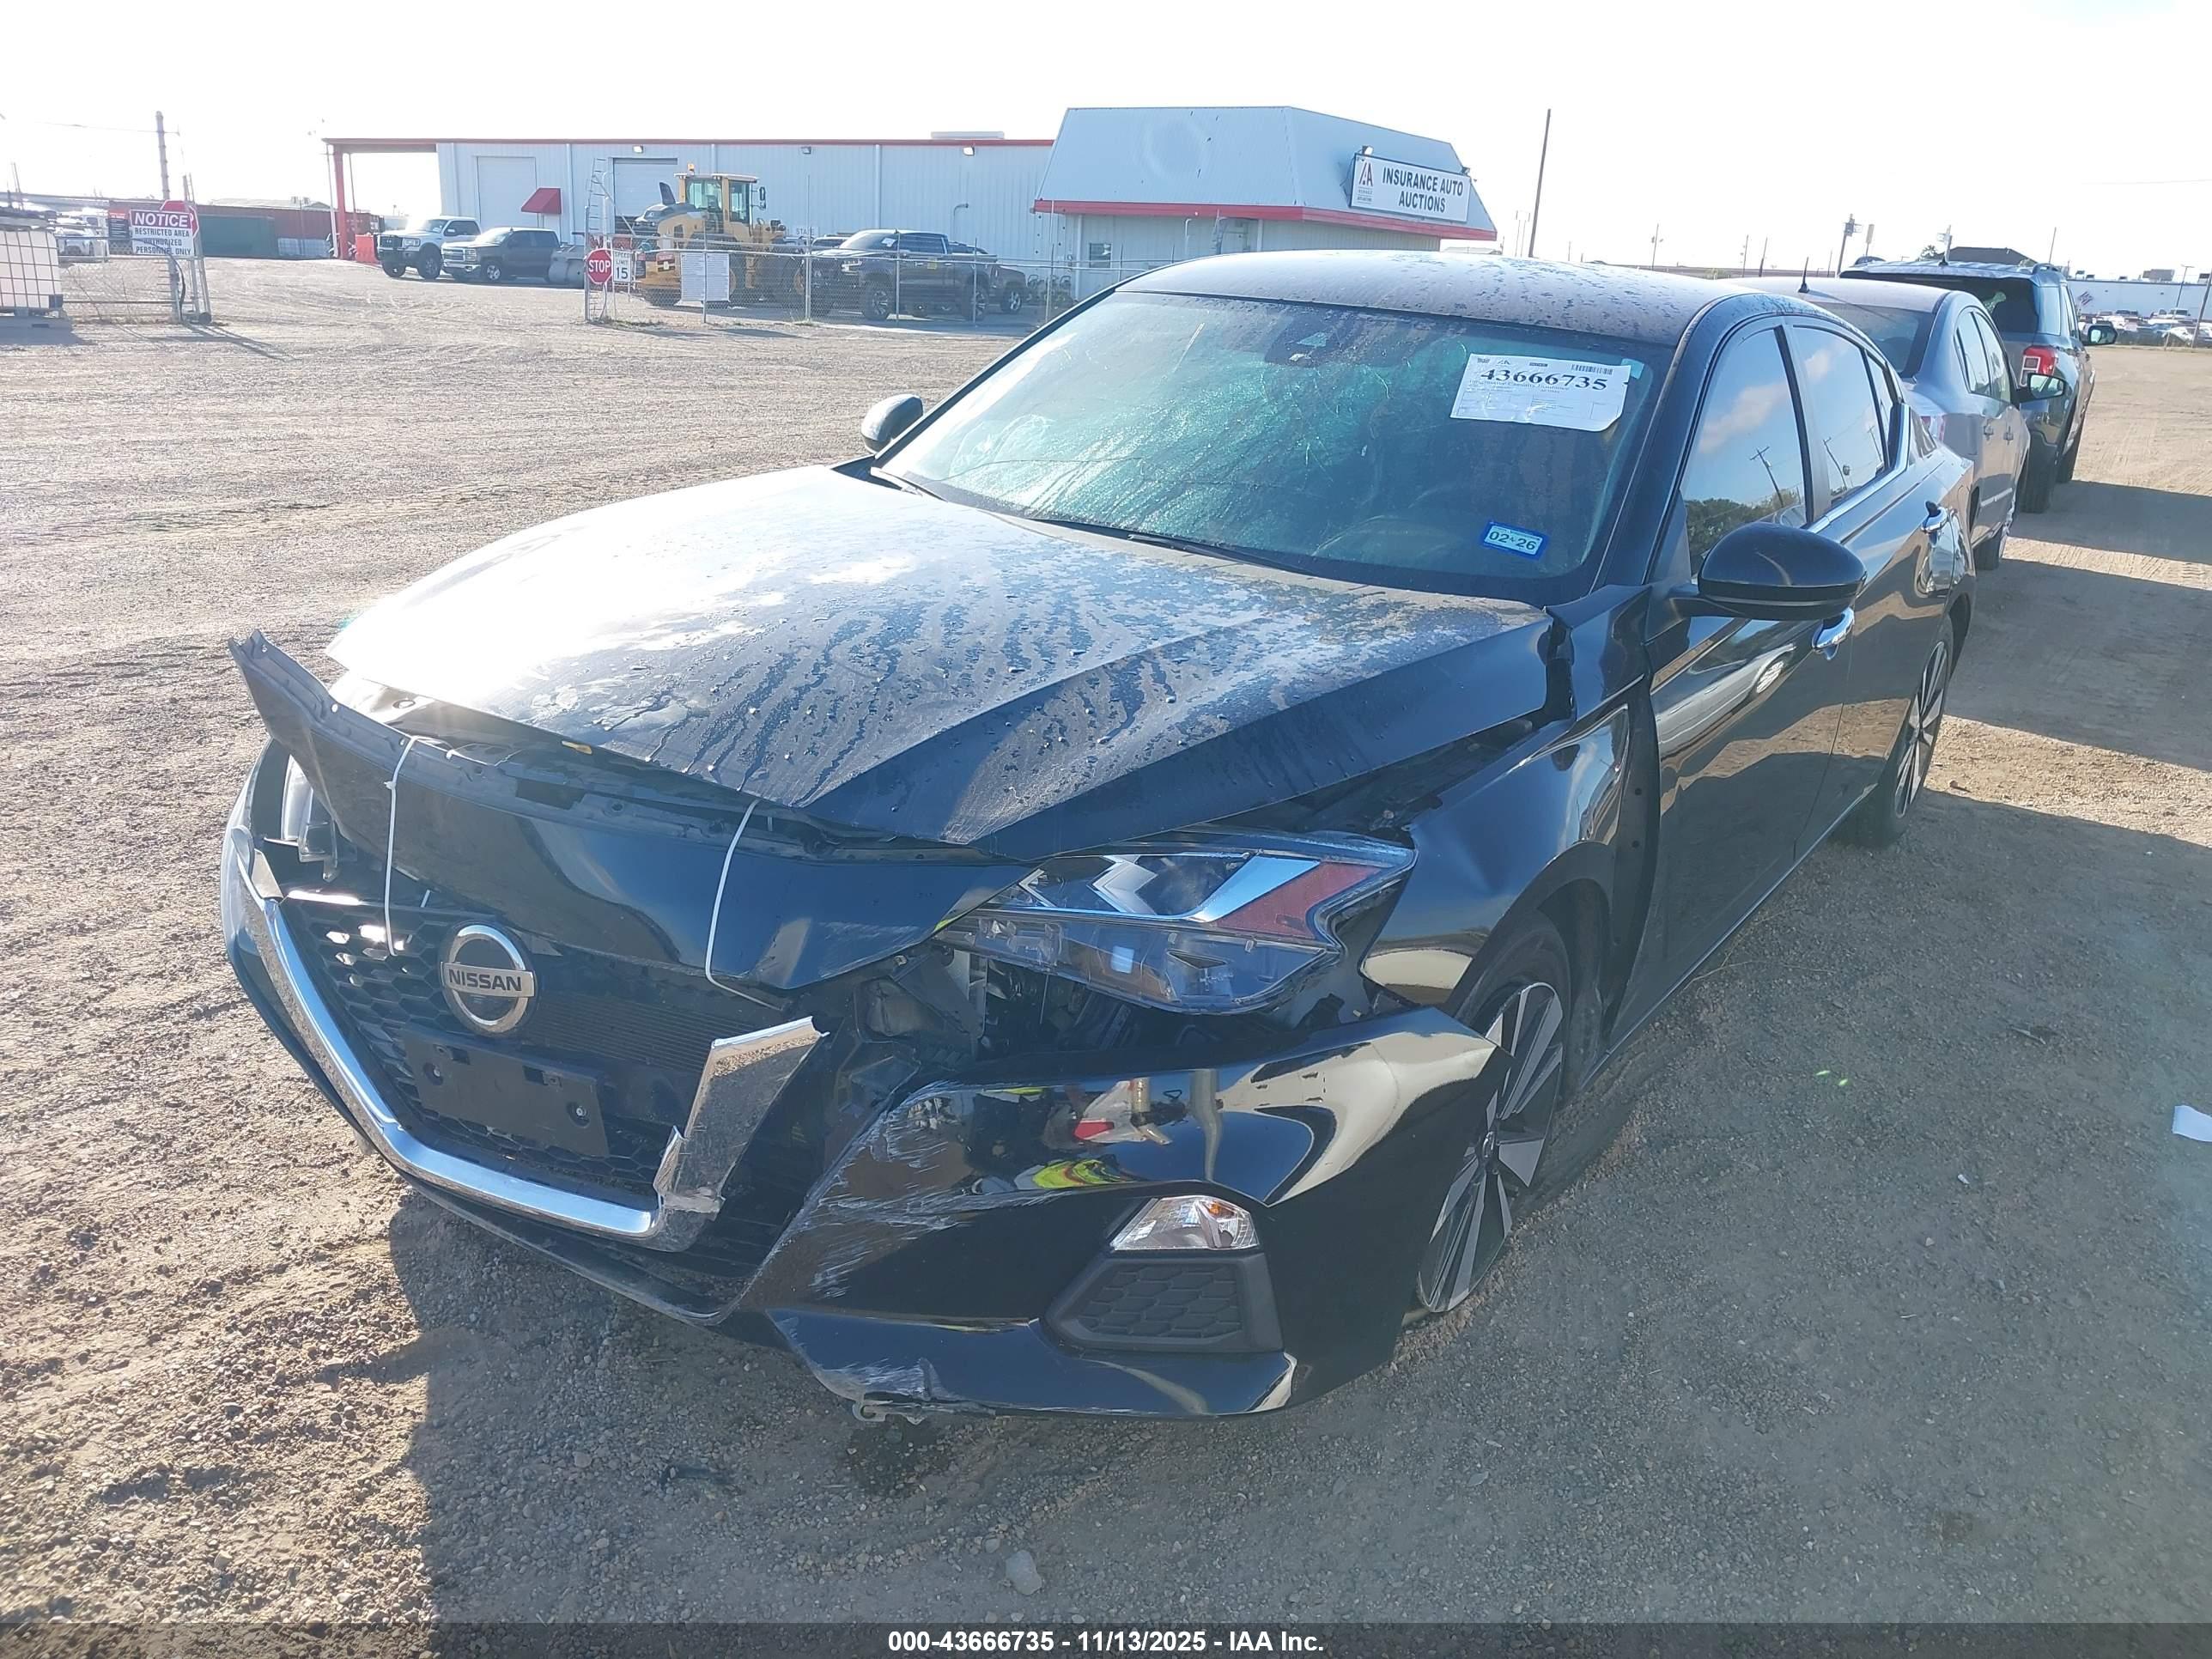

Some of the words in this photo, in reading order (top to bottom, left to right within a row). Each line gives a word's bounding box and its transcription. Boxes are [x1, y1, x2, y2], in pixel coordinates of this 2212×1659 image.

[1382, 167, 1438, 192] INSURANCE
[1440, 178, 1464, 197] AUTO
[1399, 191, 1446, 214] AUCTIONS
[134, 212, 188, 228] NOTICE
[135, 227, 172, 236] RESTRICTED
[588, 259, 611, 273] STOP
[617, 267, 629, 280] 15
[1480, 368, 1608, 391] 43666735
[448, 969, 522, 992] NISSAN
